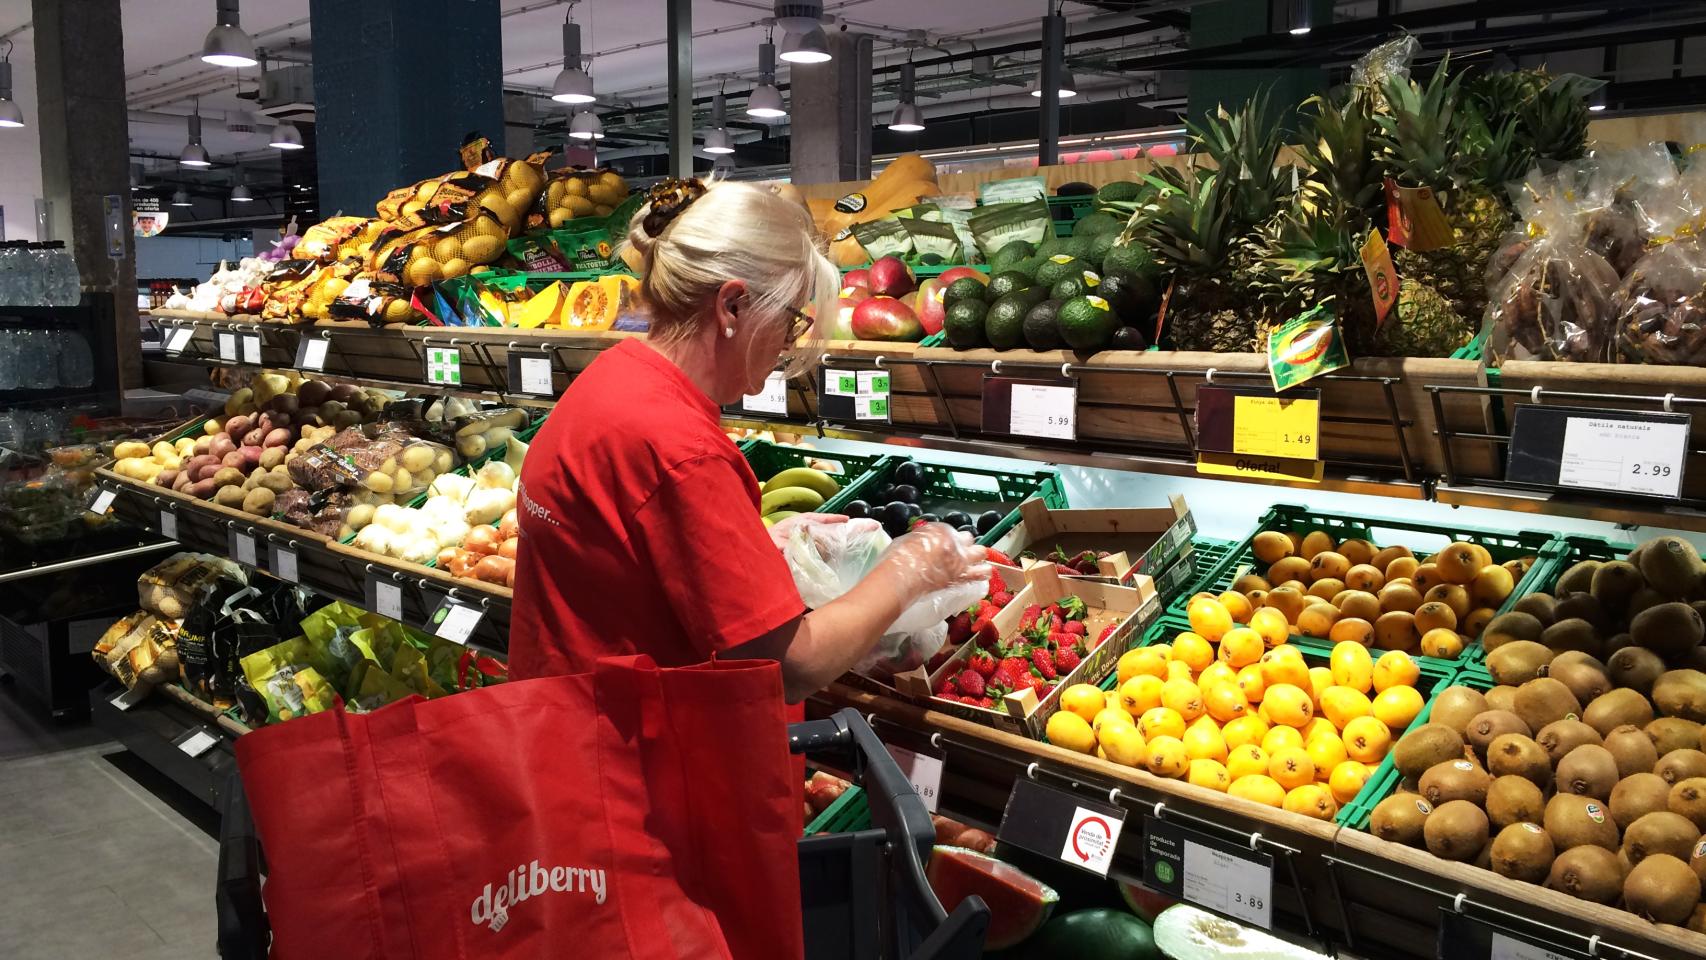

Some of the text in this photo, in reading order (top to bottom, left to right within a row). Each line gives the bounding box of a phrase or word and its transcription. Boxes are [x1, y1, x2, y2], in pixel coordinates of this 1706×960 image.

[1048, 416, 1069, 425] 5.99
[1284, 434, 1311, 444] 1.49
[1235, 459, 1280, 473] Oferta!
[1632, 463, 1671, 477] 2.99
[1101, 654, 1118, 672] Doux
[1149, 834, 1176, 847] producte
[1149, 846, 1181, 861] temporada
[471, 859, 607, 925] deliberry
[1234, 892, 1264, 910] 3.89
